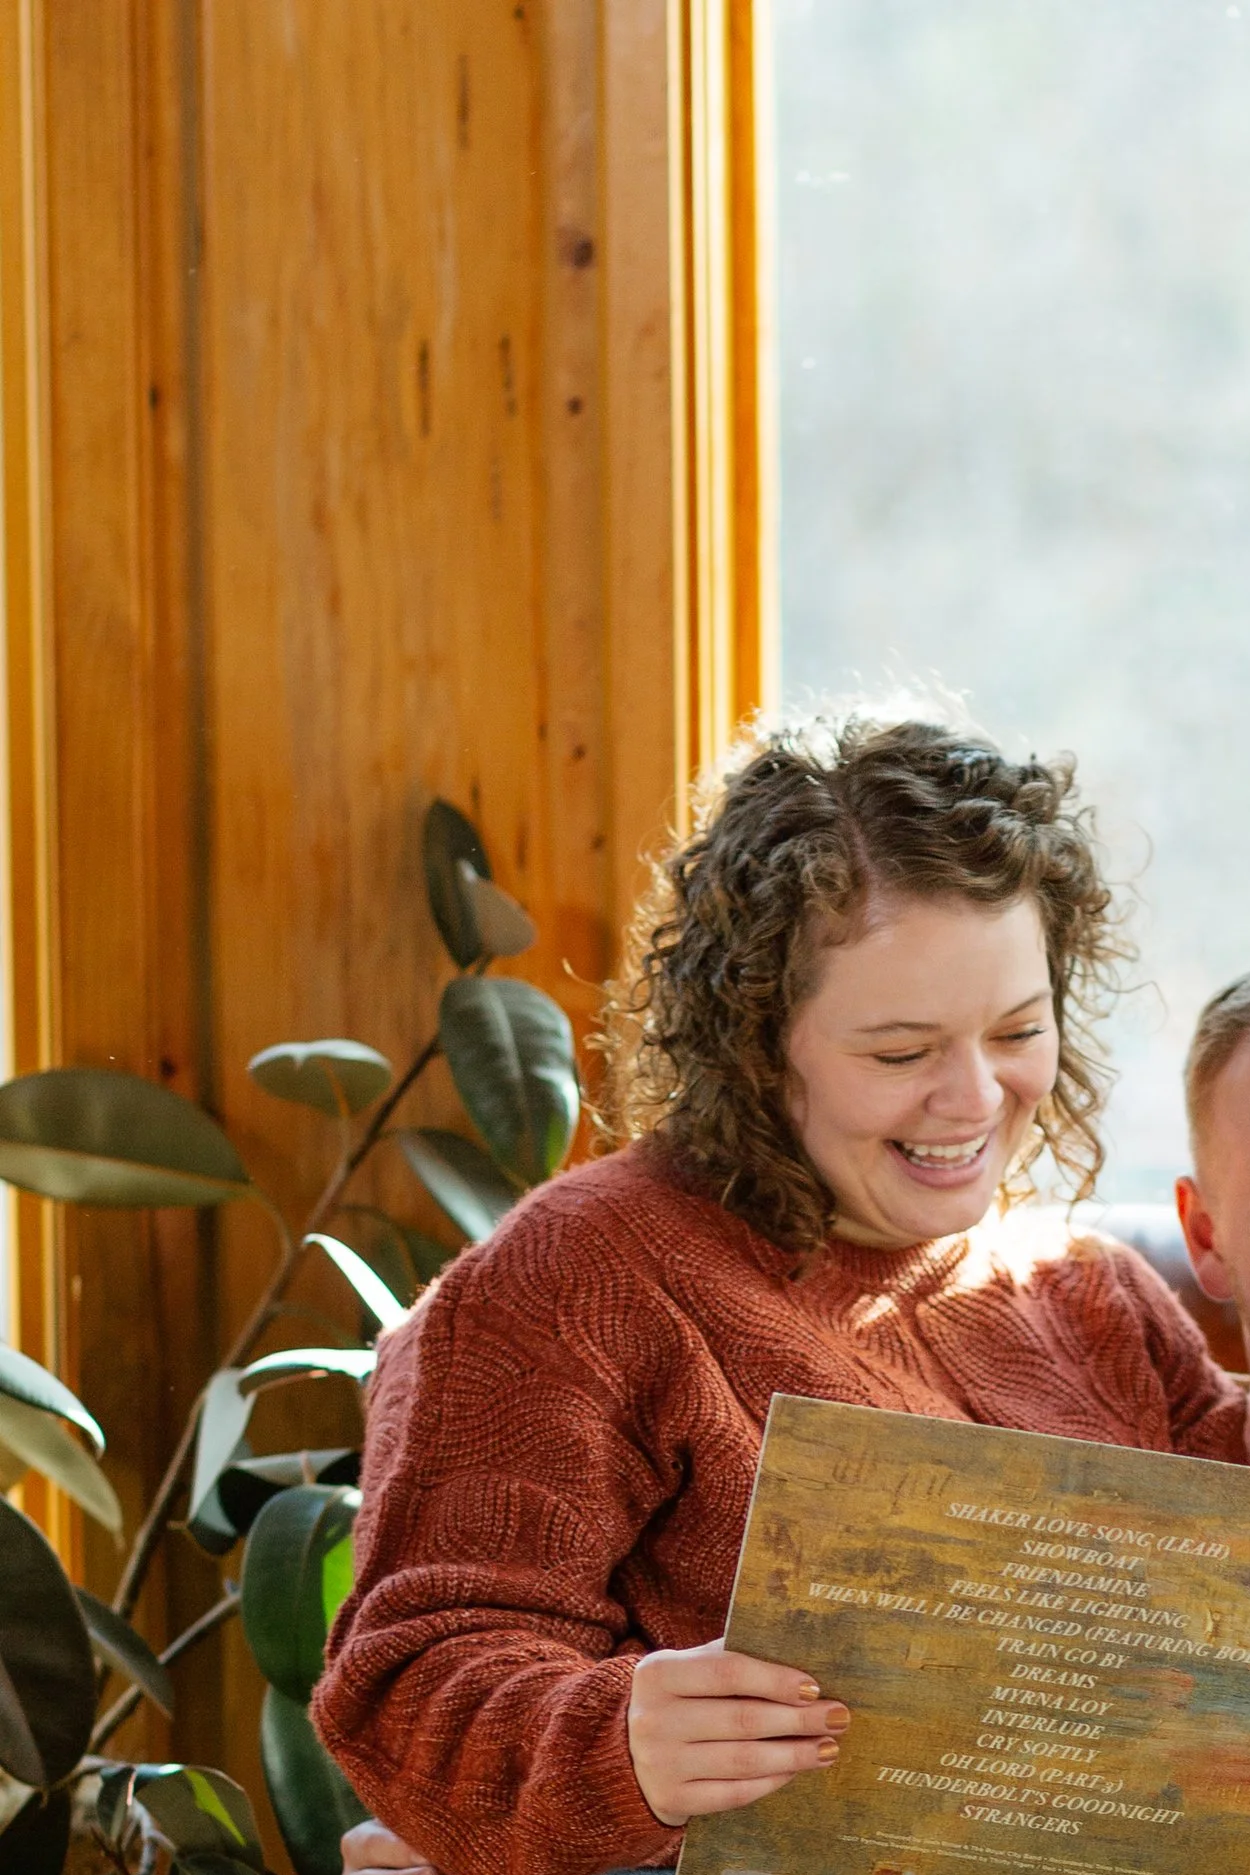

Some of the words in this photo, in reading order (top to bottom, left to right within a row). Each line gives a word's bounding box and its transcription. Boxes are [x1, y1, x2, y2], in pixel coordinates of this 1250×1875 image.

[945, 1502, 1031, 1529] SHAKER
[1032, 1516, 1093, 1538] LOVE
[1093, 1525, 1155, 1548] SONG
[1156, 1535, 1231, 1561] (LEAH)
[1019, 1540, 1144, 1571] SHOWBOAT
[1000, 1562, 1150, 1598] FRIENDAMINE
[808, 1582, 876, 1605] WHEN
[875, 1592, 928, 1615] WILL
[932, 1604, 943, 1617] I
[945, 1604, 976, 1621] BE
[977, 1609, 1082, 1638] CHANGED
[1084, 1626, 1210, 1657] (FEATURING
[949, 1580, 1015, 1602] FEELS
[1015, 1591, 1069, 1611] LIKE
[1067, 1597, 1191, 1629] LIGHTNING
[995, 1637, 1062, 1659] TRAIN
[1064, 1648, 1097, 1665] GO
[1100, 1652, 1131, 1669] BY
[1009, 1664, 1099, 1690] DREAMS
[988, 1686, 1063, 1710] MYRNA
[1067, 1699, 1114, 1717] LOY
[981, 1709, 1105, 1741] INTERLUDE
[976, 1733, 1021, 1752] CRY
[1021, 1739, 1101, 1764] SOFTLY
[939, 1752, 975, 1770] OH
[975, 1759, 1037, 1780] LORD
[1039, 1767, 1102, 1790] (PART
[1100, 1778, 1124, 1795] 3)
[875, 1766, 1049, 1806] THUNDERBOLT'S
[1050, 1794, 1185, 1825] GOODNIGHT
[960, 1805, 1083, 1836] STRANGERS
